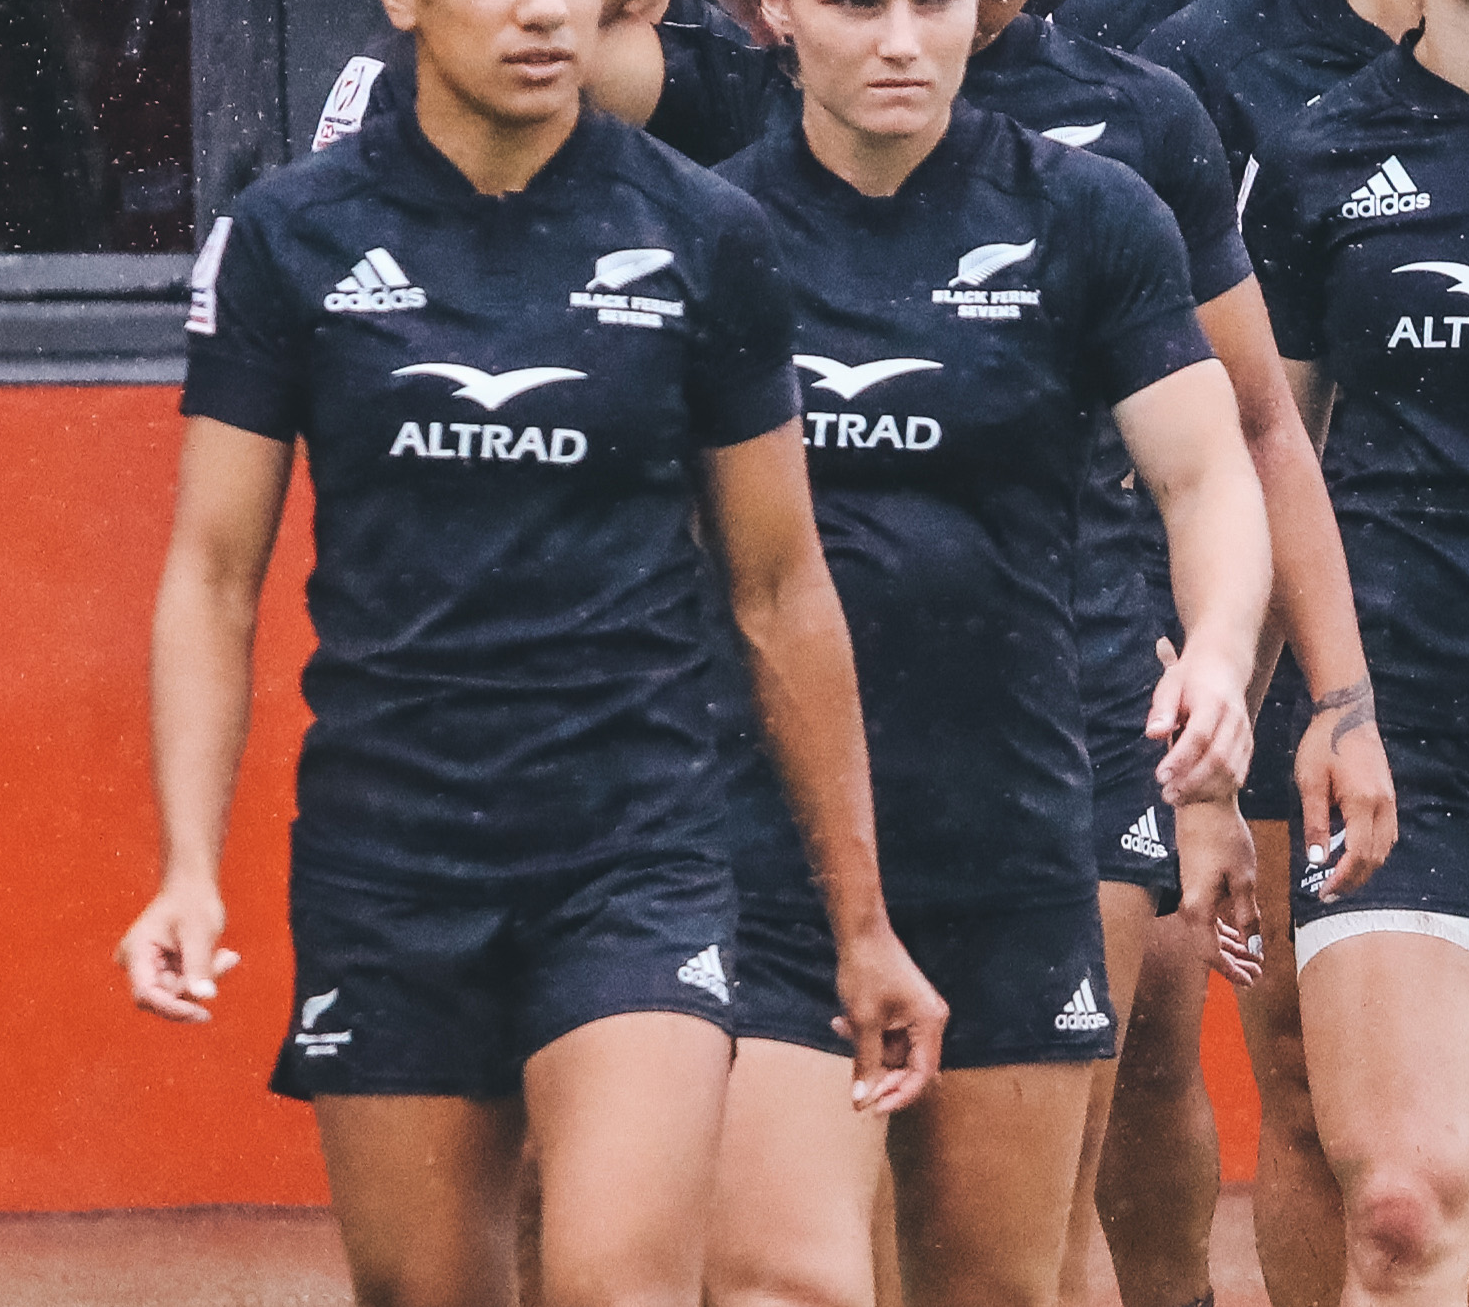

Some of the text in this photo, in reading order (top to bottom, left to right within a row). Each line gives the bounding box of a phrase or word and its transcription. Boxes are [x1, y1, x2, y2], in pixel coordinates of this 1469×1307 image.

[1341, 190, 1431, 219] adidas
[323, 285, 428, 313] adidas
[931, 289, 989, 305] BLACK
[957, 304, 1021, 319] SEVENS
[389, 421, 588, 464] ALTRAD
[803, 411, 943, 451] TRAD
[1120, 832, 1169, 859] adidas
[1054, 1010, 1110, 1031] adidas
